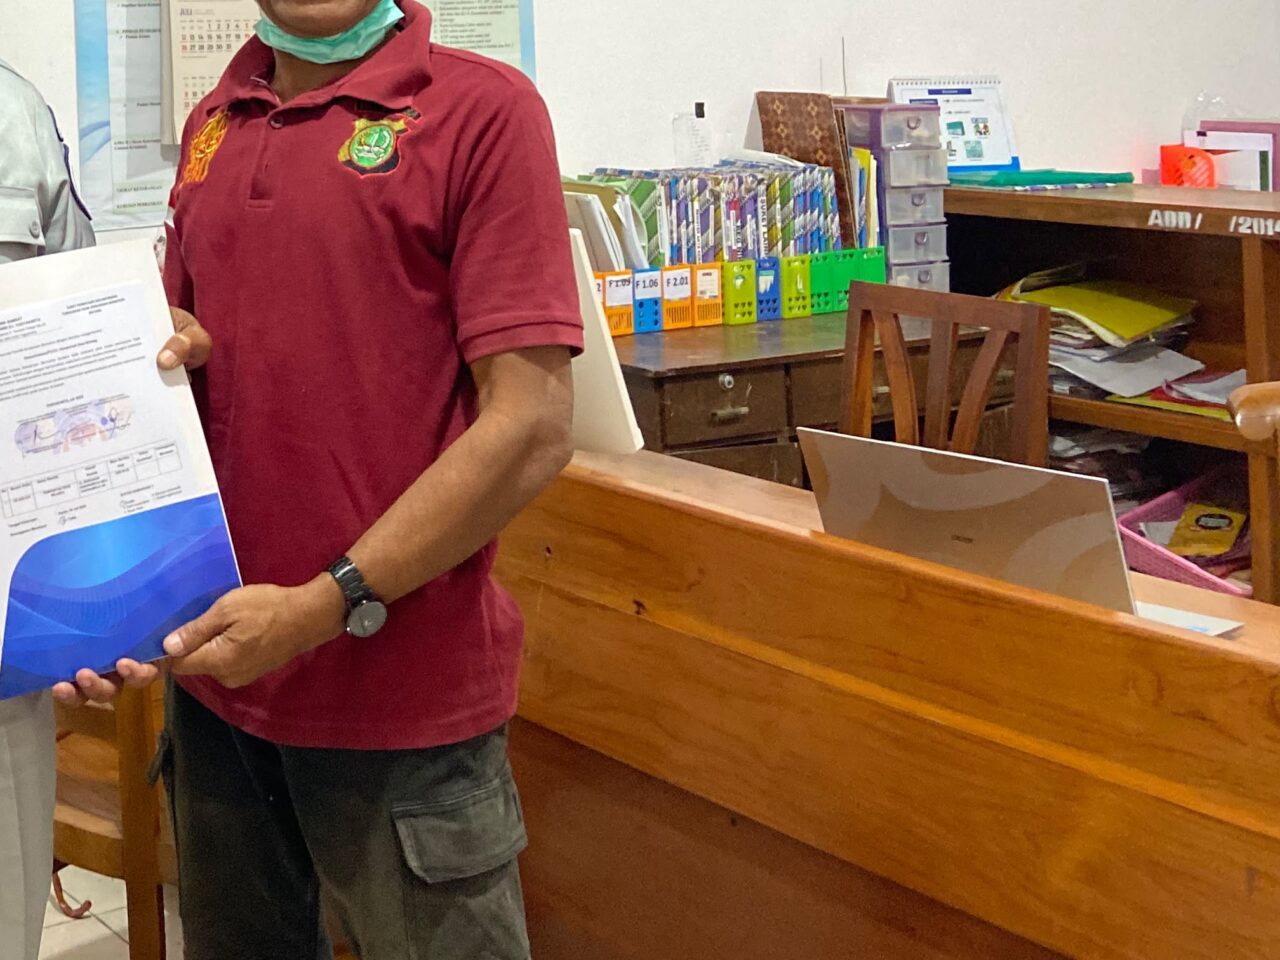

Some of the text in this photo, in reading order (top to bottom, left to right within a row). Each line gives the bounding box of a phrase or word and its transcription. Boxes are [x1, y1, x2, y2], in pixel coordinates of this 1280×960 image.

[636, 279, 658, 288] F 1.06
[673, 276, 688, 286] 2.01
